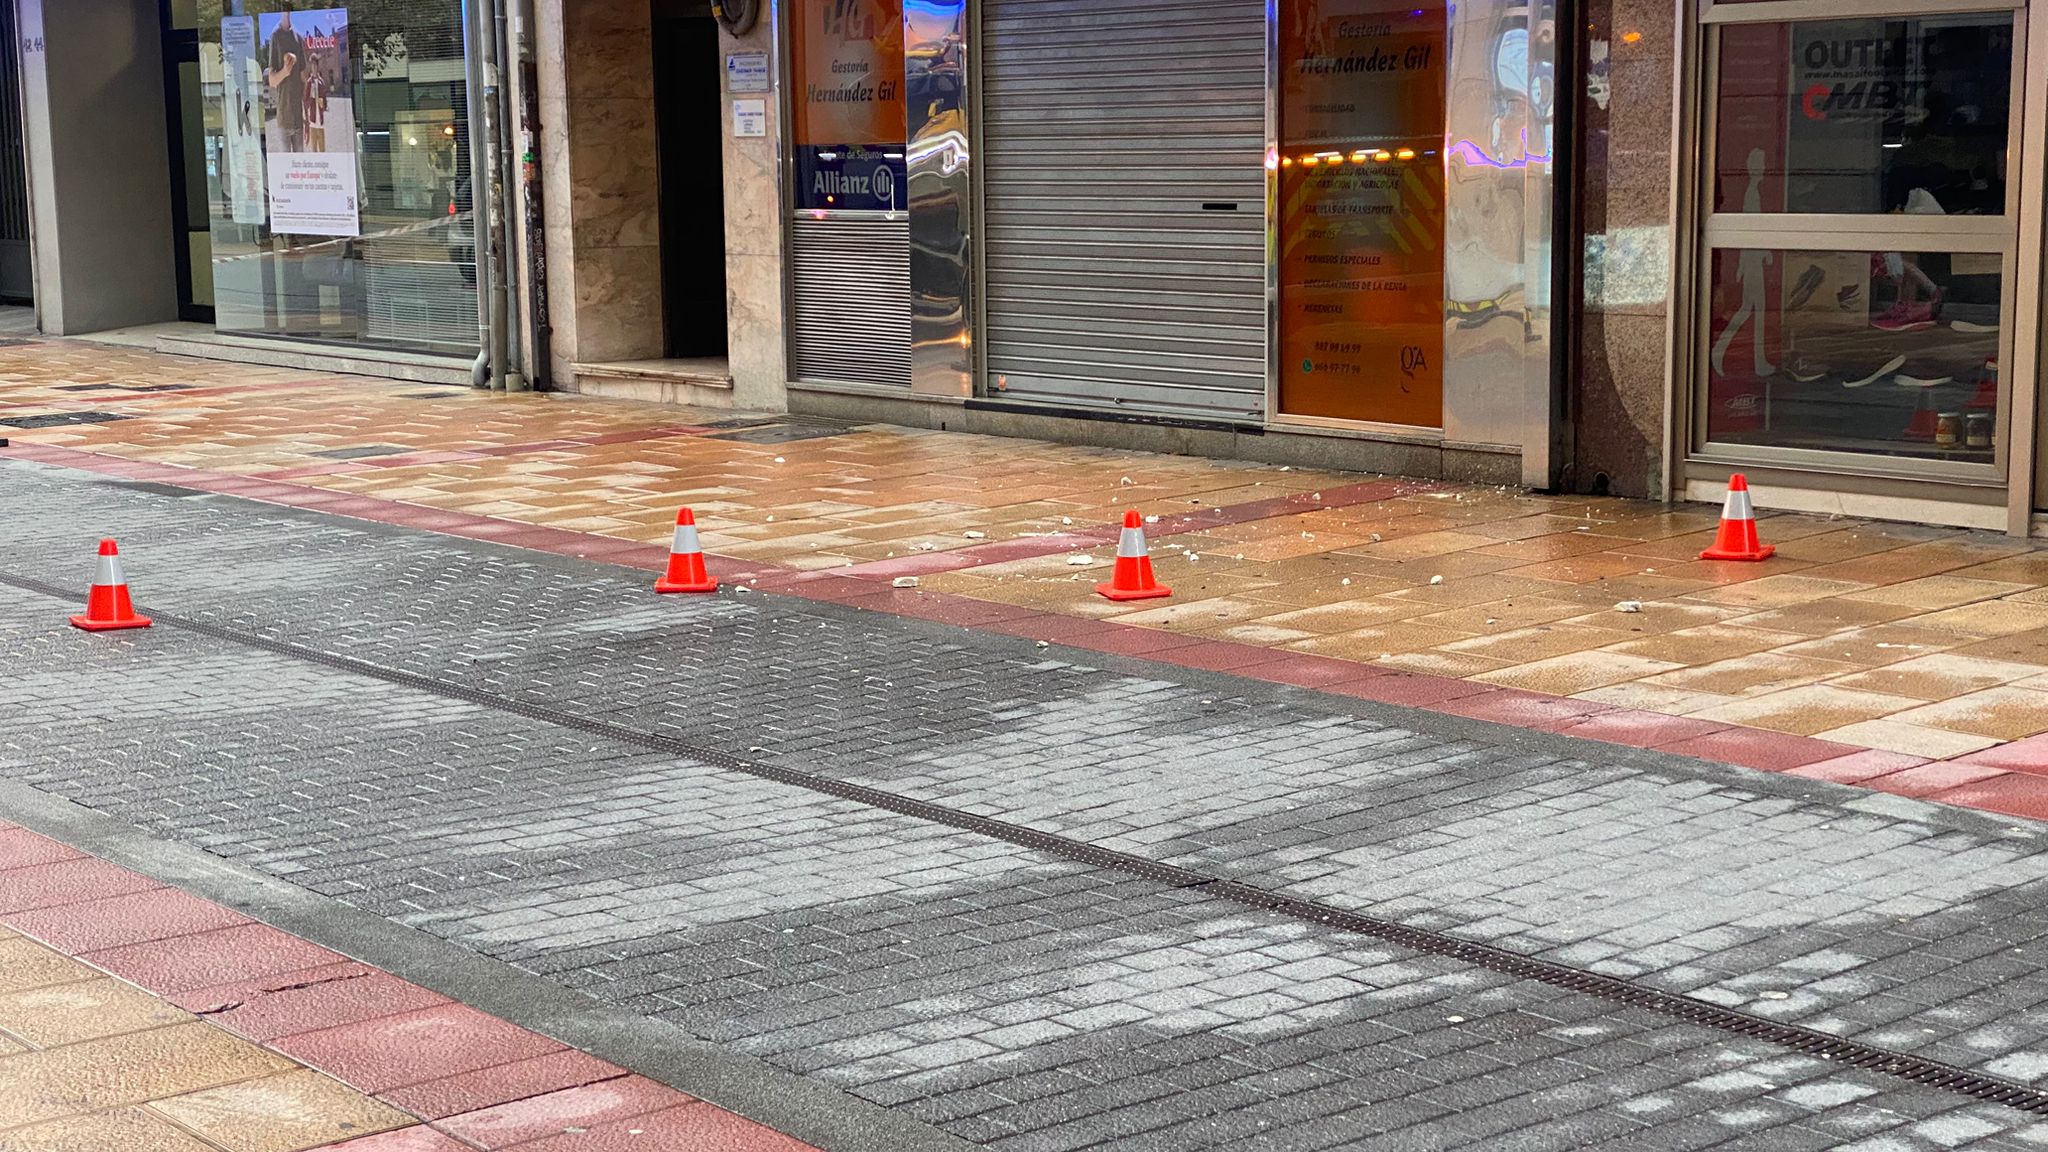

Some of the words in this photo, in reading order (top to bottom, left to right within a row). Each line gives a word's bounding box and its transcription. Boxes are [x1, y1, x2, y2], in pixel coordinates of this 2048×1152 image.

[831, 59, 869, 74] Gestoría
[1301, 47, 1399, 75] Hernández
[1403, 45, 1431, 70] Gil
[807, 81, 874, 104] Hernández
[877, 80, 897, 101] Gil
[813, 170, 870, 194] Allianz
